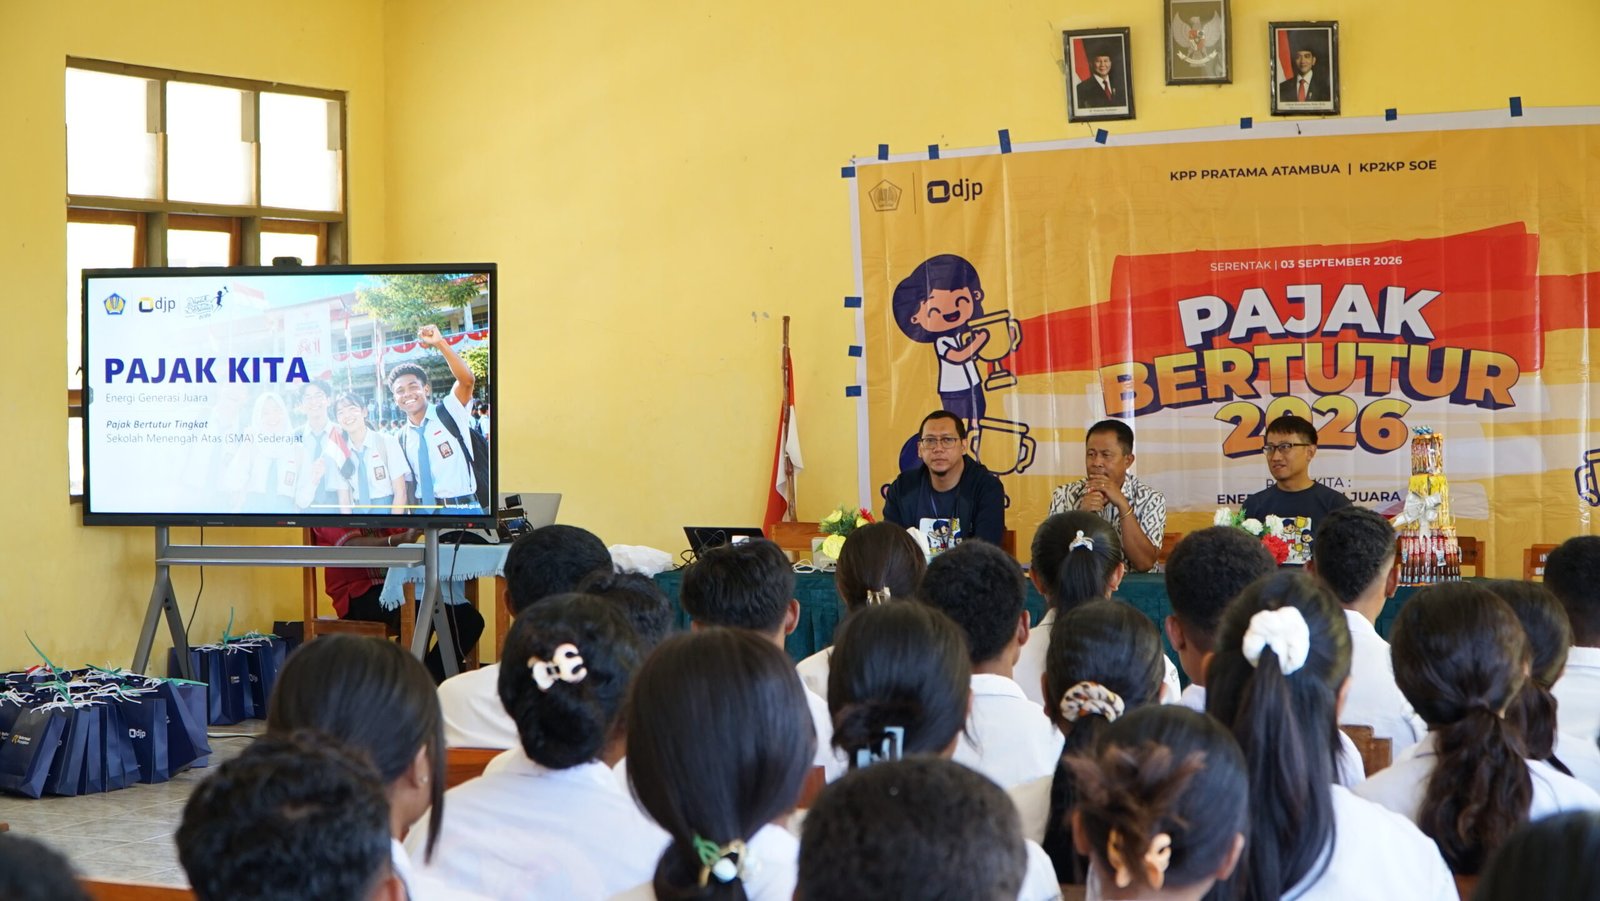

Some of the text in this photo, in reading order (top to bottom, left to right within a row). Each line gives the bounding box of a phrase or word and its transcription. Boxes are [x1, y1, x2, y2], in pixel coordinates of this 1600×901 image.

[1170, 170, 1197, 181] KPP
[1201, 167, 1268, 180] PRATAMA
[1271, 164, 1341, 177] ATAMBUA
[1359, 161, 1405, 173] KP2KP
[1409, 160, 1437, 171] SOE
[952, 178, 983, 201] djp
[1210, 261, 1272, 272] SERENTAK
[1280, 259, 1295, 269] 03
[1298, 257, 1371, 269] SEPTEMBER
[1373, 256, 1403, 266] 2026
[155, 297, 176, 312] djp
[1178, 284, 1442, 347] PAJAK
[105, 357, 310, 384] PAJAK KITA
[1099, 342, 1520, 418] BERTUTUR
[105, 393, 208, 405] Energi Generasi Juara
[106, 420, 208, 430] Pajak Bertutur Tingkat
[106, 434, 304, 445] Sekolah Menengah Atas (SMA) Sederajat
[1217, 494, 1247, 505] ENE
[1351, 491, 1401, 503] JUARA
